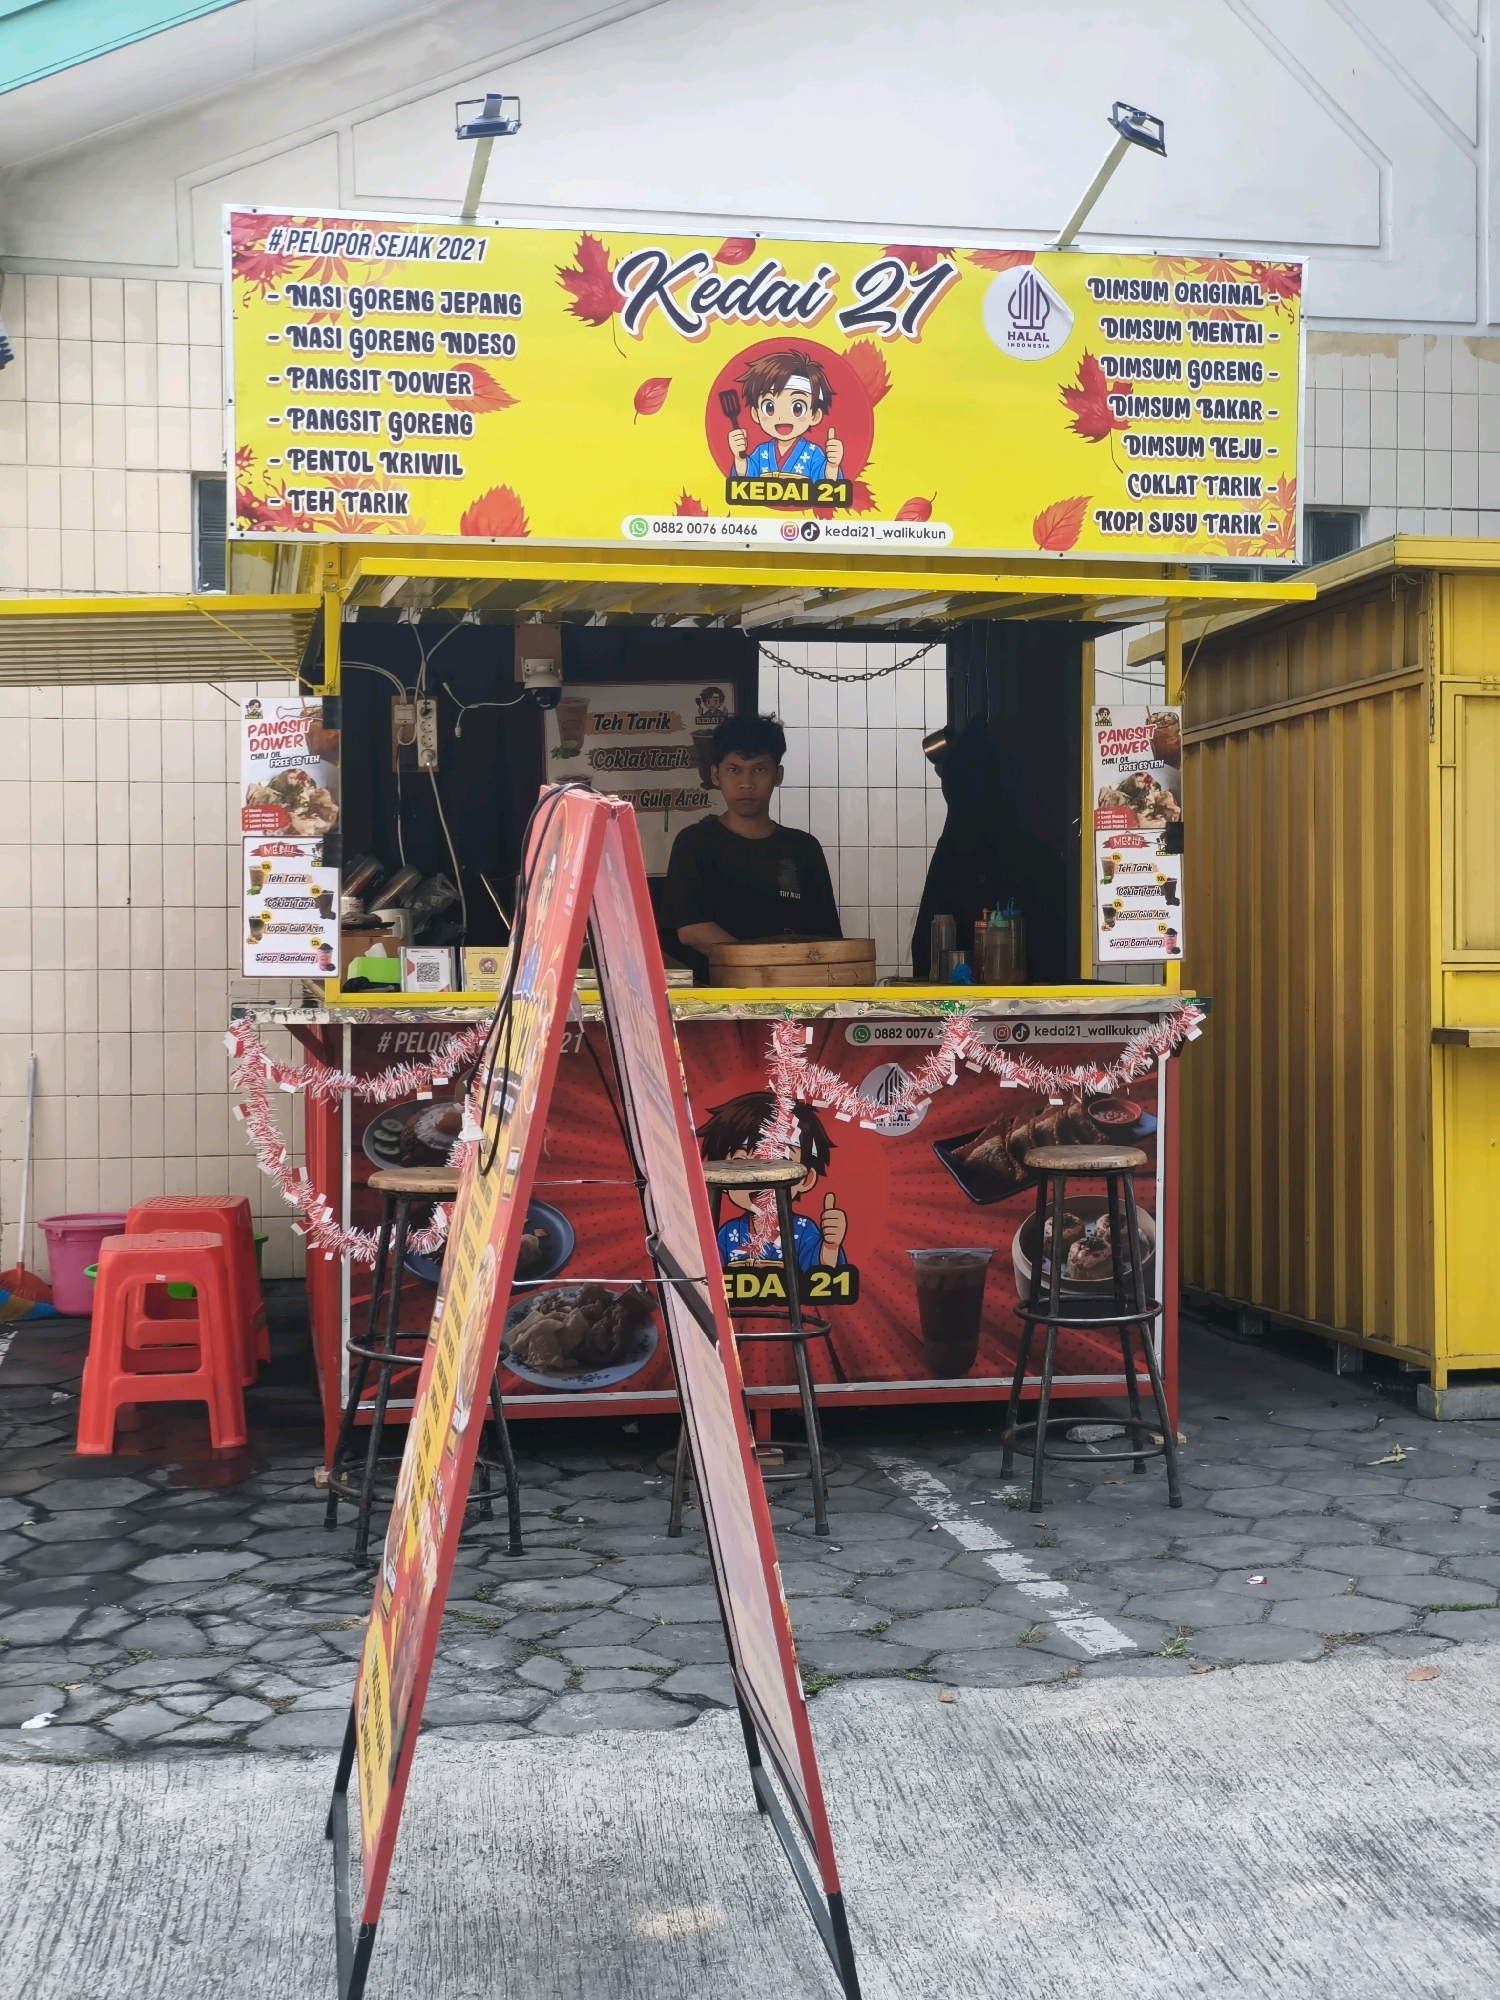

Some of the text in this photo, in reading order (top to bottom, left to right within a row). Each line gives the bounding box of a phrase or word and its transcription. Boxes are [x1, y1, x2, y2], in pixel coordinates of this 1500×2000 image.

[375, 233, 434, 259] SEJAK
[436, 237, 487, 261] 2021
[285, 284, 342, 308] NASI
[349, 286, 435, 317] GORENG
[440, 292, 522, 315] JEPANG
[617, 250, 954, 335] Kedai 21
[1087, 278, 1169, 301] DIMSUM
[1174, 282, 1263, 305] ORIGINAL
[1008, 331, 1050, 342] HALAL
[1100, 317, 1182, 341] DIMSUM
[1187, 321, 1263, 344] MENTAI
[285, 325, 342, 349] NASI
[349, 328, 435, 358] GORENG
[440, 333, 516, 356] NDESO
[286, 367, 382, 391] PANGSIT
[386, 370, 472, 395] DOWER
[1100, 356, 1182, 380] DIMSUM
[1187, 360, 1263, 388] GORENG
[1109, 395, 1190, 418] DIMSUM
[1196, 398, 1263, 421] BAKAR
[286, 408, 382, 433] PANGSIT
[388, 411, 473, 441] GORENG
[1123, 435, 1204, 457] DIMSUM
[1210, 437, 1262, 459] KEJU
[286, 449, 374, 473] PENTOL
[379, 451, 464, 476] KRIWIL
[730, 480, 847, 502] KEDAI 21
[1127, 473, 1198, 497] COKLAT
[1202, 475, 1262, 497] TARIK
[287, 490, 335, 513] TEH
[341, 491, 409, 514] TARIK
[652, 522, 758, 536] 0882 0076 60466
[1095, 510, 1143, 532] KOPI
[1148, 512, 1197, 533] SUSU
[1202, 514, 1261, 534] TARIK
[825, 526, 946, 540] kedai21_walikukun
[247, 719, 312, 738] PANGSIT
[593, 712, 671, 731] Teh Tarik
[249, 734, 304, 752] DOWER
[1097, 725, 1156, 744] PANGSIT
[250, 752, 269, 760] CHILI
[1100, 740, 1150, 758] DOWER
[269, 755, 320, 768] FREE ES TEH
[593, 749, 690, 769] Coklat Tarik
[1101, 758, 1118, 766] CHILI
[1119, 760, 1165, 772] FREE ES TEH
[640, 790, 672, 807] Gula
[675, 789, 709, 807] Aren
[263, 845, 295, 855] MENU
[1113, 836, 1141, 847] MENU
[1118, 863, 1153, 873] Teh Tarik
[268, 874, 307, 883] Teh Tarik
[1118, 887, 1162, 897] Coklat Tarik
[267, 898, 315, 908] Coklat Tarik
[1118, 910, 1169, 920] Kopsu Gula Aren
[266, 924, 324, 933] Kopsu Gula Aren
[1130, 938, 1163, 948] Bandung
[280, 953, 316, 964] Bandung
[874, 1028, 903, 1039] 0882
[905, 1028, 934, 1039] 0076
[722, 1271, 850, 1298] EDA 21
